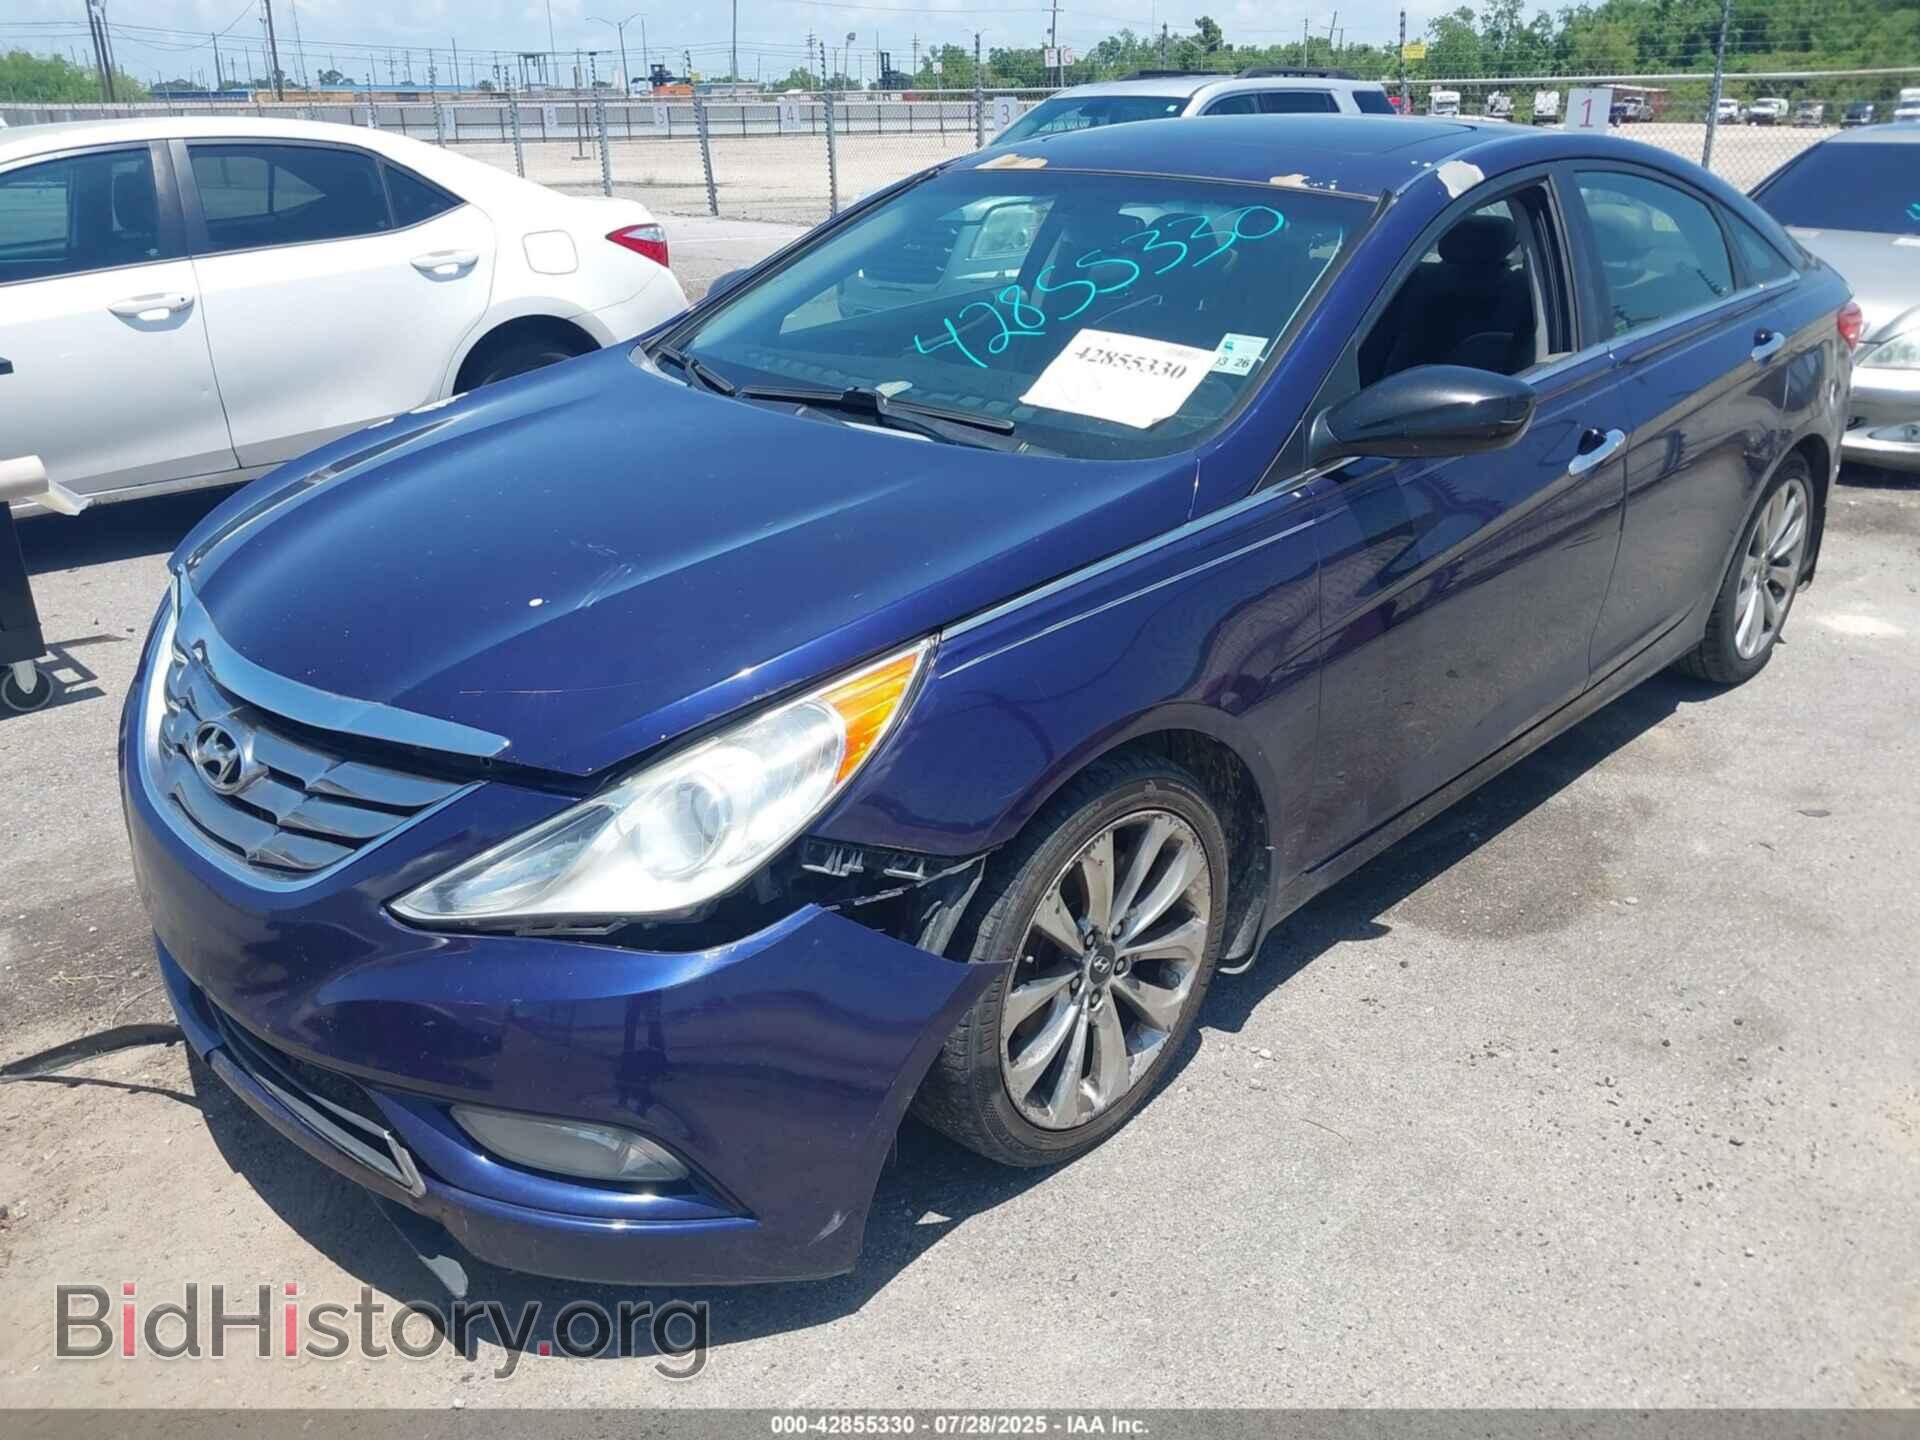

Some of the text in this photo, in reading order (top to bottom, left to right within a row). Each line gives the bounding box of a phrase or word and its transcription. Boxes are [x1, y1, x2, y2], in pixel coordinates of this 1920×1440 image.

[1000, 103, 1011, 126] 3
[1579, 98, 1594, 128] 1
[914, 205, 1285, 369] 42855330
[1074, 346, 1188, 380] 42855330
[1234, 357, 1249, 369] 26
